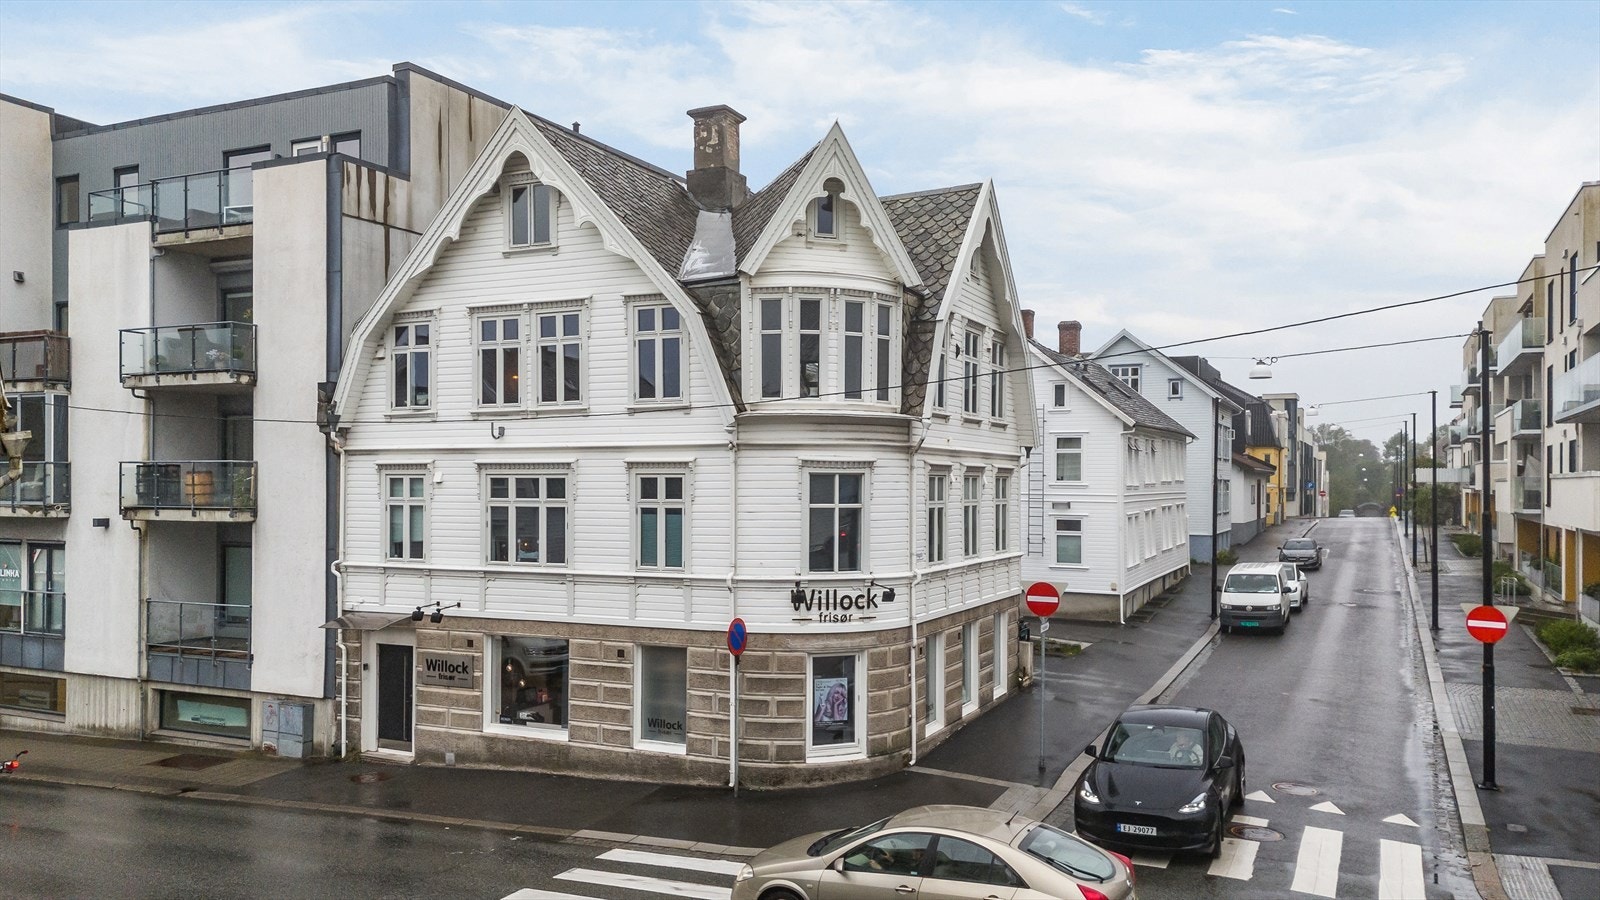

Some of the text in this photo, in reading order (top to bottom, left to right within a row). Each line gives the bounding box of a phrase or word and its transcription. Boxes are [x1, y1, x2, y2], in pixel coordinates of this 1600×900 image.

[791, 588, 878, 611] Willock
[819, 612, 853, 623] frisør
[426, 658, 469, 675] Willock
[647, 718, 683, 730] Willock
[1133, 826, 1154, 834] 29077
